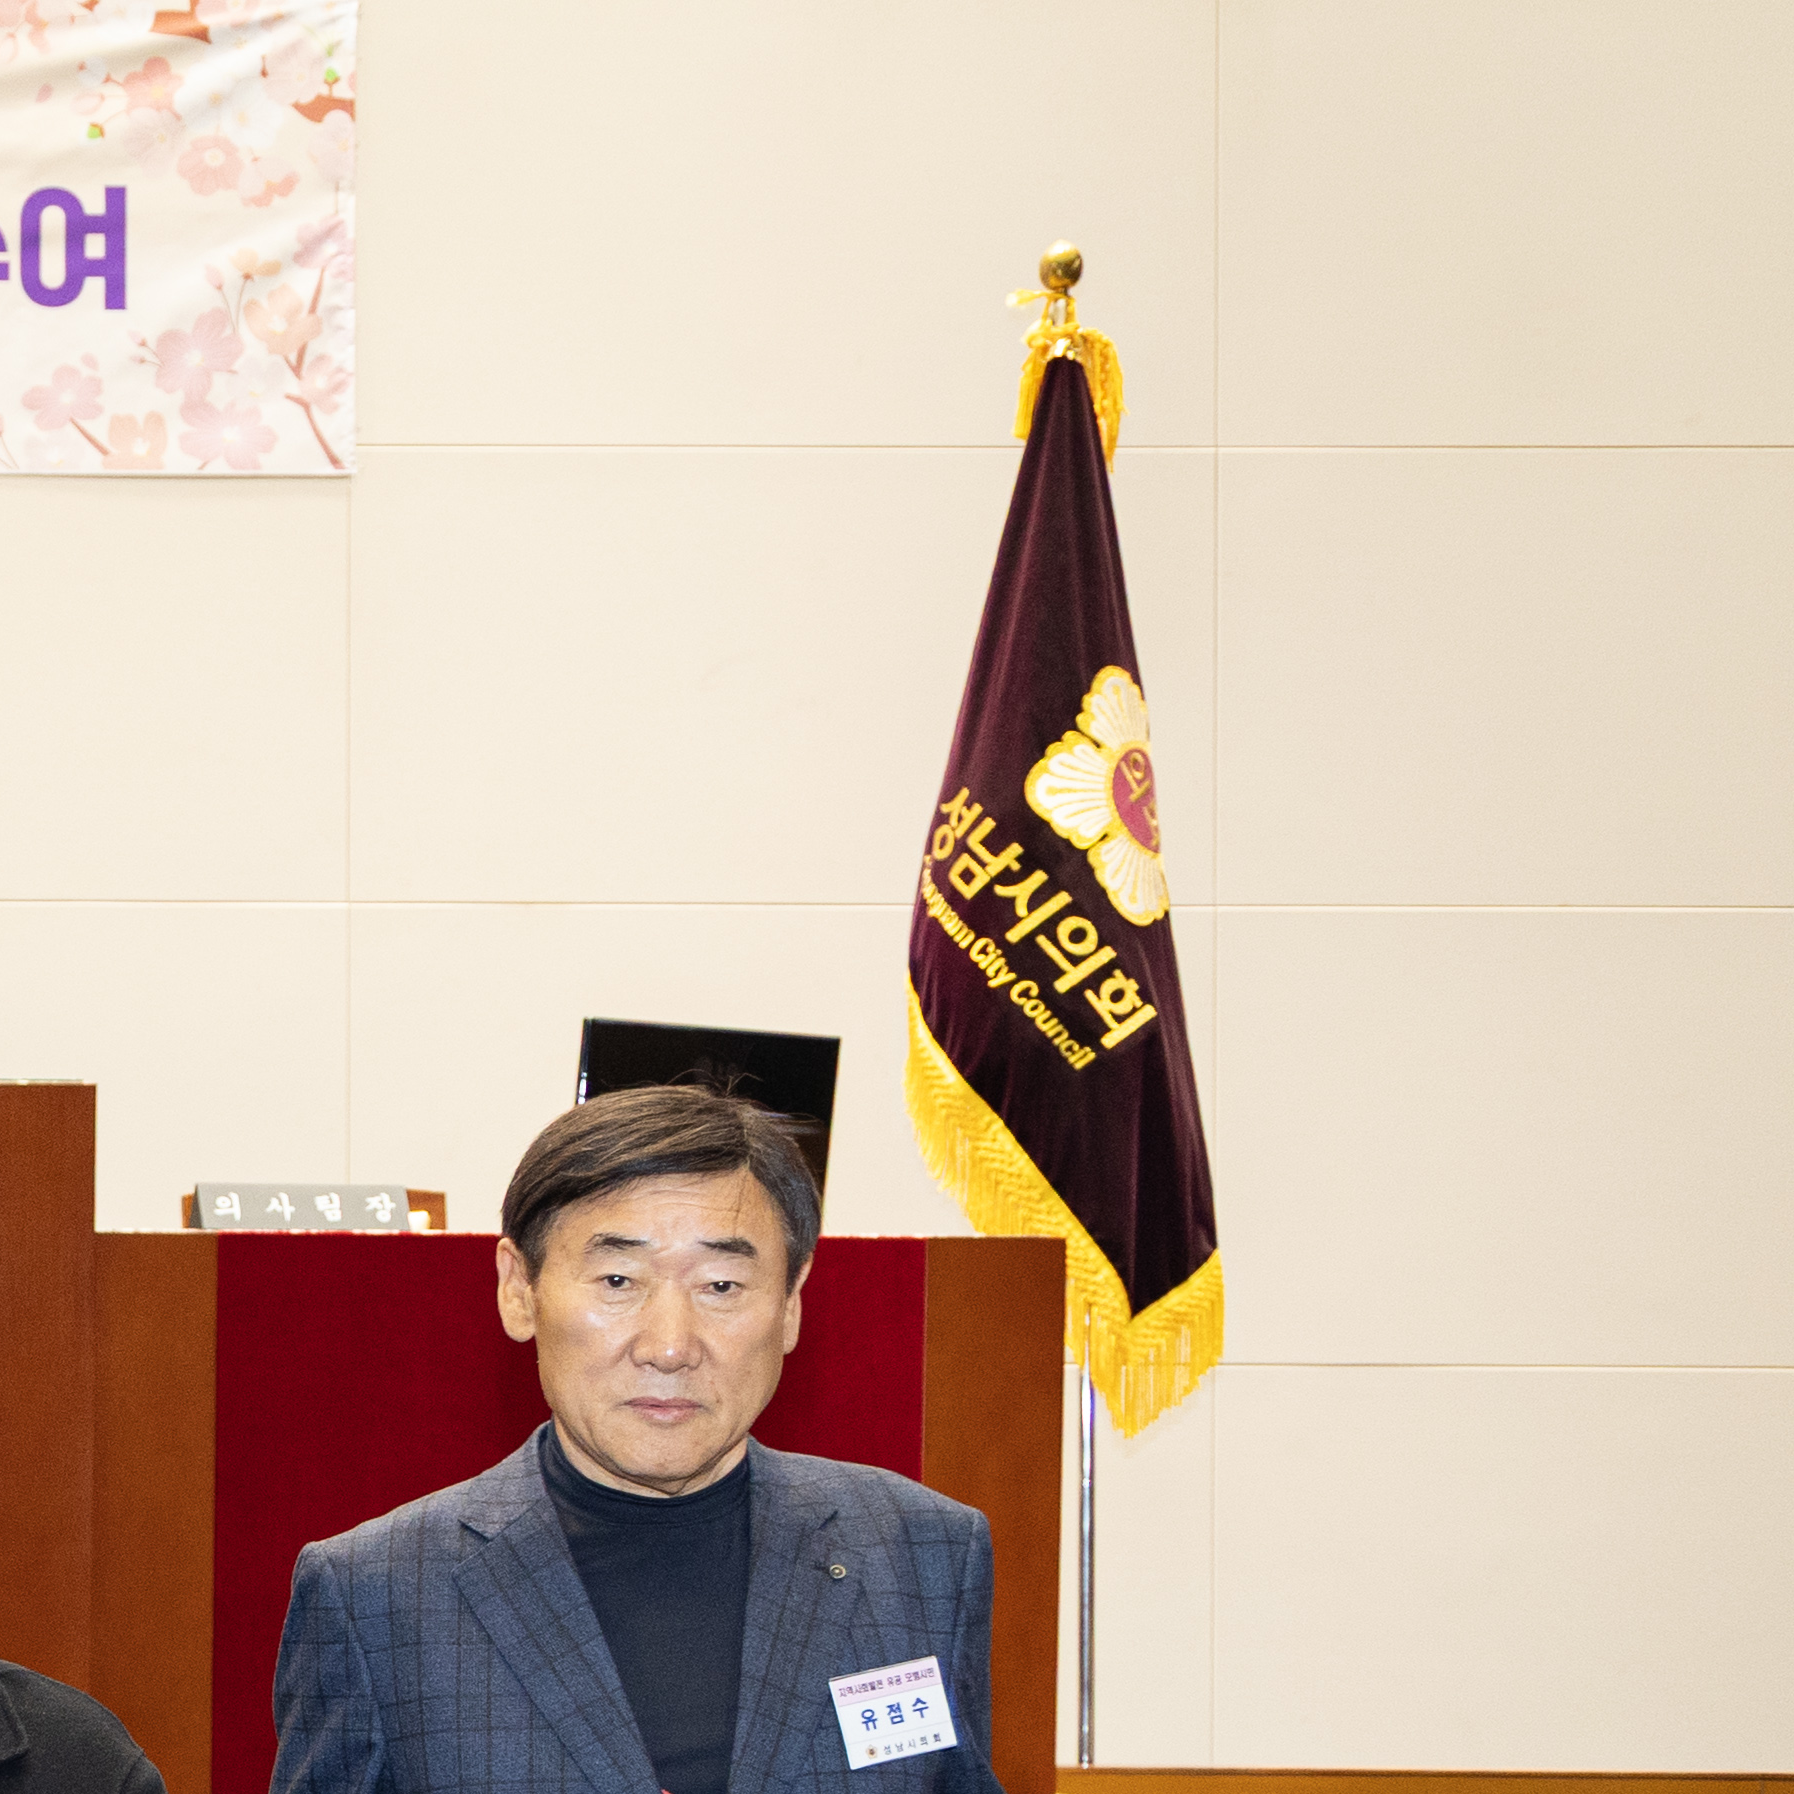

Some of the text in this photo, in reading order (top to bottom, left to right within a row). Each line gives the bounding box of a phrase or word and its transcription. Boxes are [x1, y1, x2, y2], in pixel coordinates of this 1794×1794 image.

[931, 787, 1158, 1050] 성남시의회
[969, 937, 1019, 990] City
[1009, 979, 1098, 1072] Council
[838, 1667, 935, 1698] 지역사회발전 유공 모범시민
